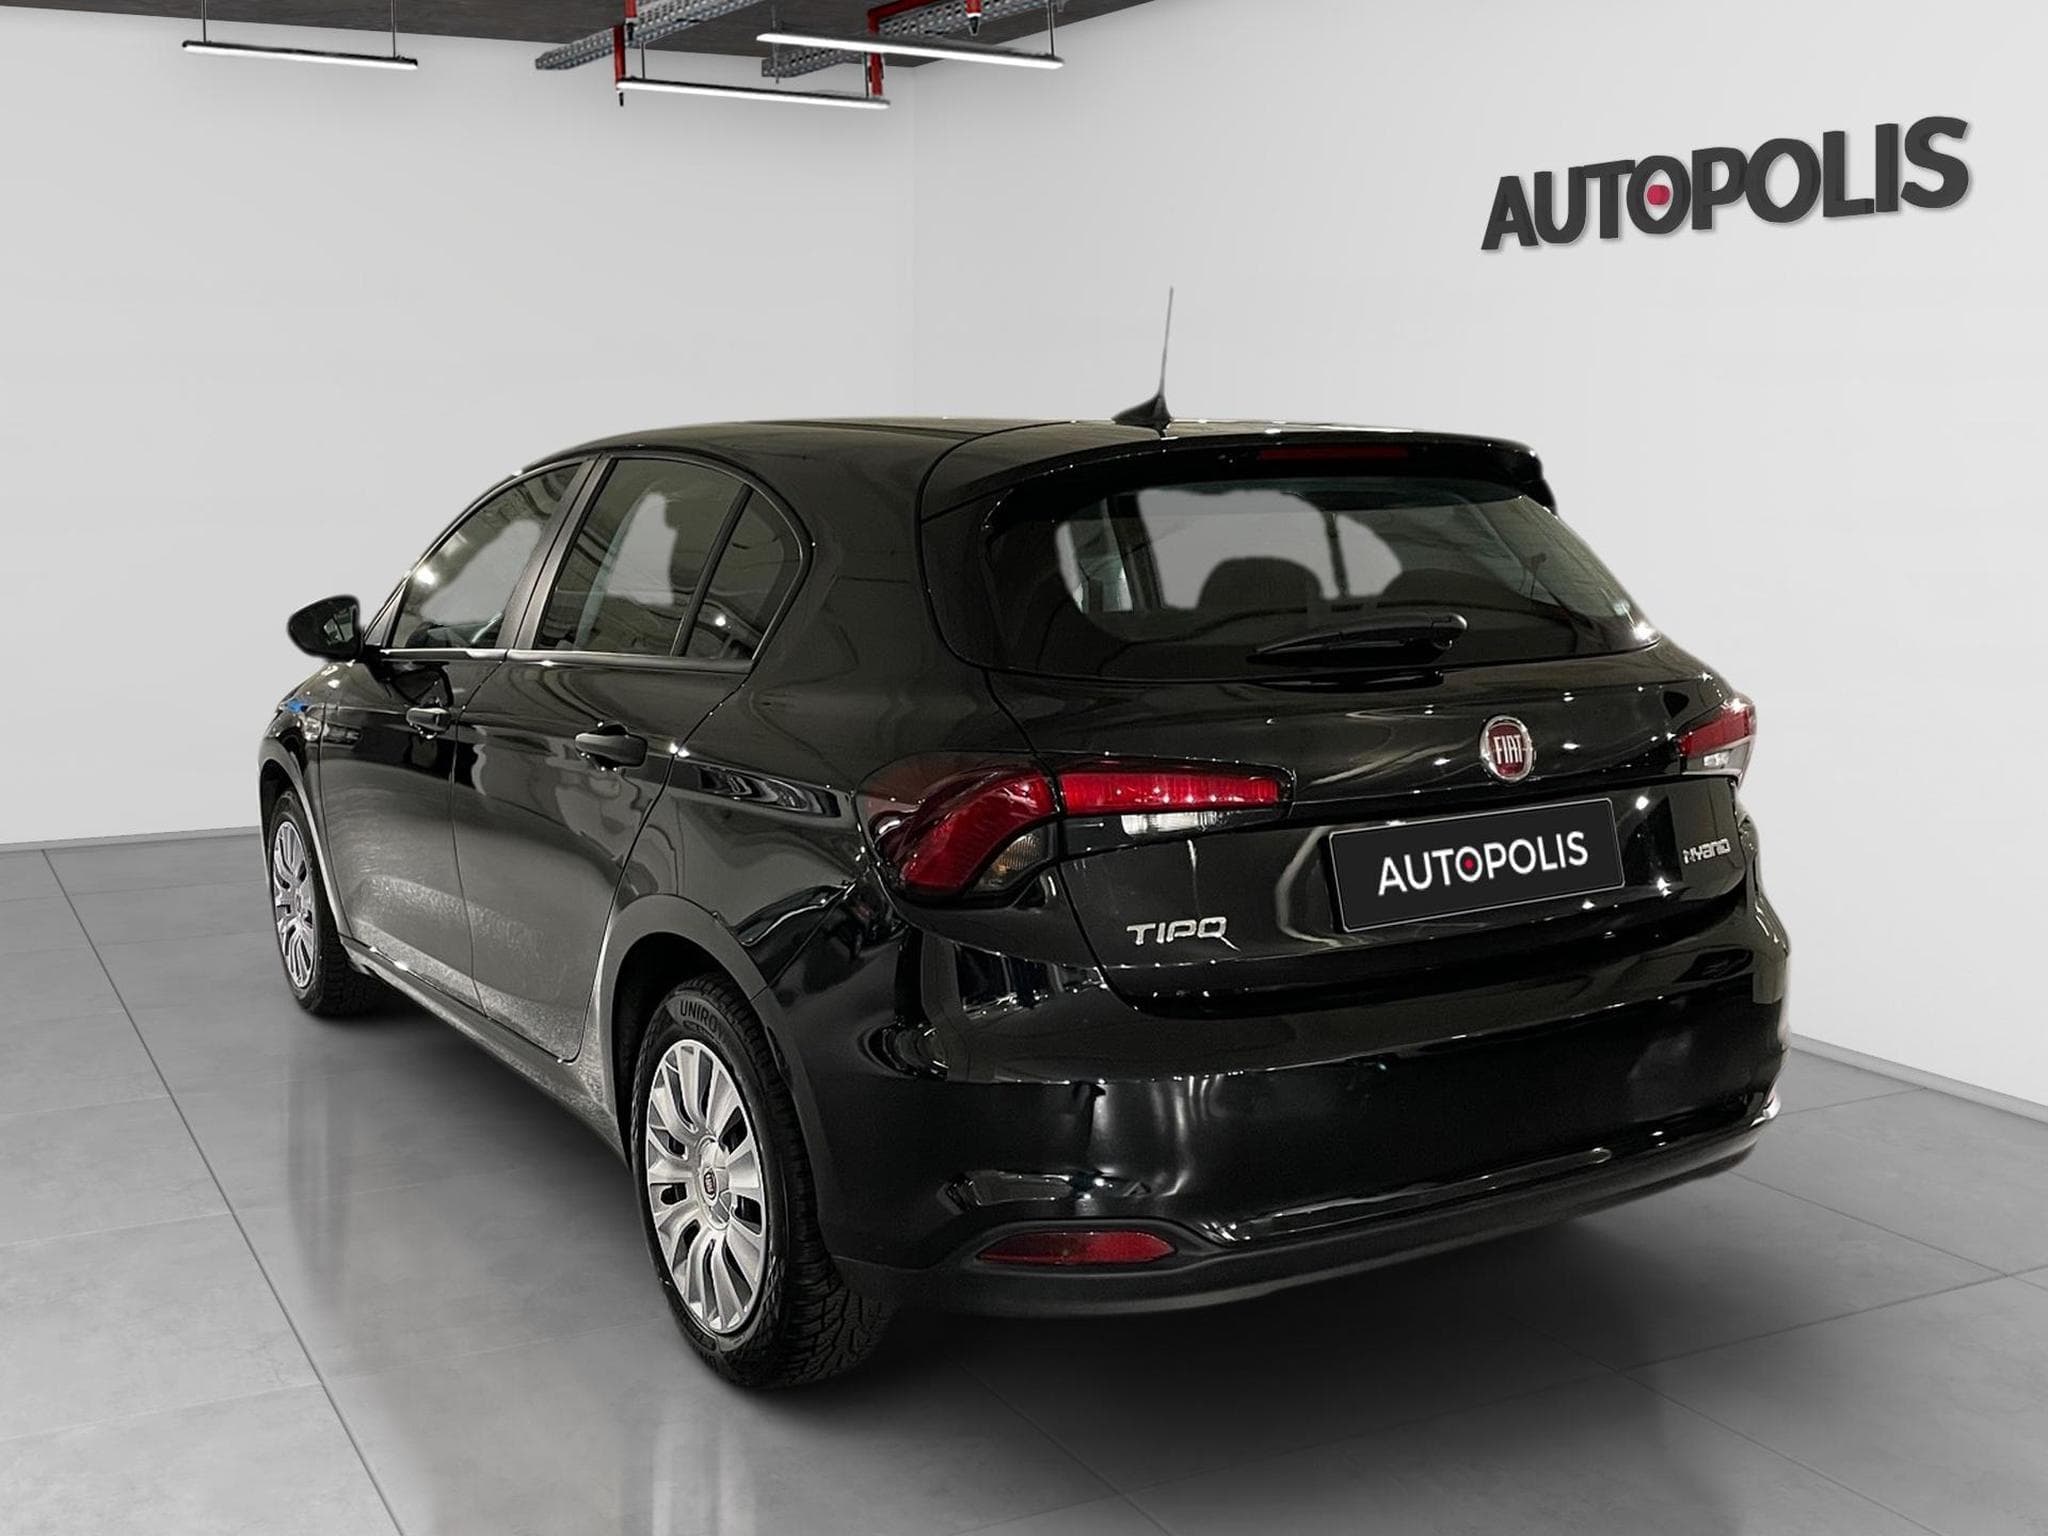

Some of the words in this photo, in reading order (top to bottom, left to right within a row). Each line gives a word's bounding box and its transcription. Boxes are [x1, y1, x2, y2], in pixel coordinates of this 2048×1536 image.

[1480, 116, 1970, 250] AUTOPOLIS
[1493, 734, 1523, 764] FIAT
[1377, 830, 1589, 896] AUTOPOLIS
[1126, 916, 1227, 945] TIPO
[680, 999, 726, 1045] UNIROY
